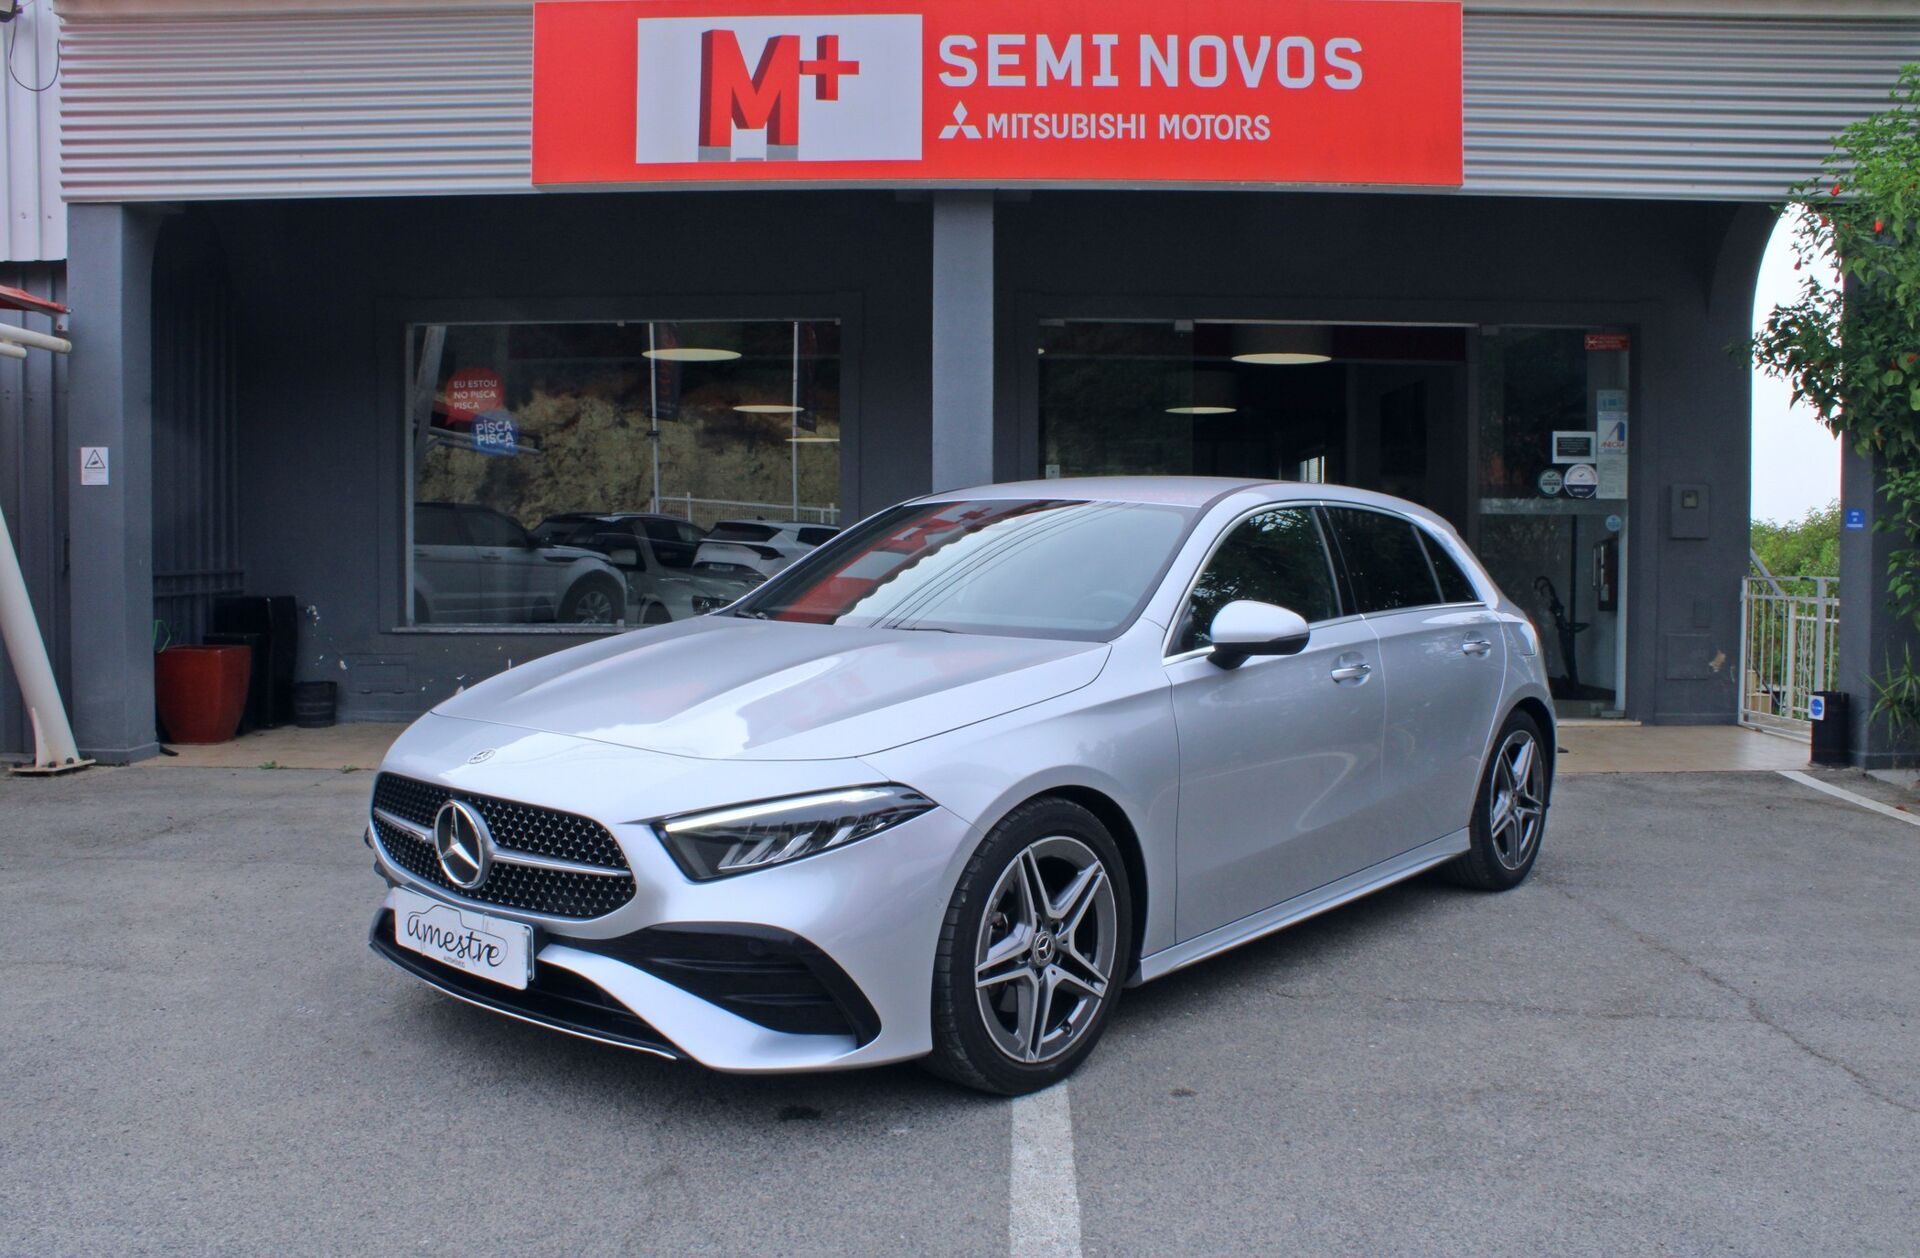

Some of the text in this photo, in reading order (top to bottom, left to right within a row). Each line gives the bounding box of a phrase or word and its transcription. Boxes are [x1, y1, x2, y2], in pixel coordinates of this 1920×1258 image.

[939, 33, 1363, 91] SEMI NOVOS
[987, 112, 1271, 142] MITSUBISHI MOTORS
[453, 380, 498, 388] EU ESTOU
[453, 390, 497, 399] NO PISCA
[453, 401, 480, 410] PISCA
[407, 914, 501, 967] amestre
